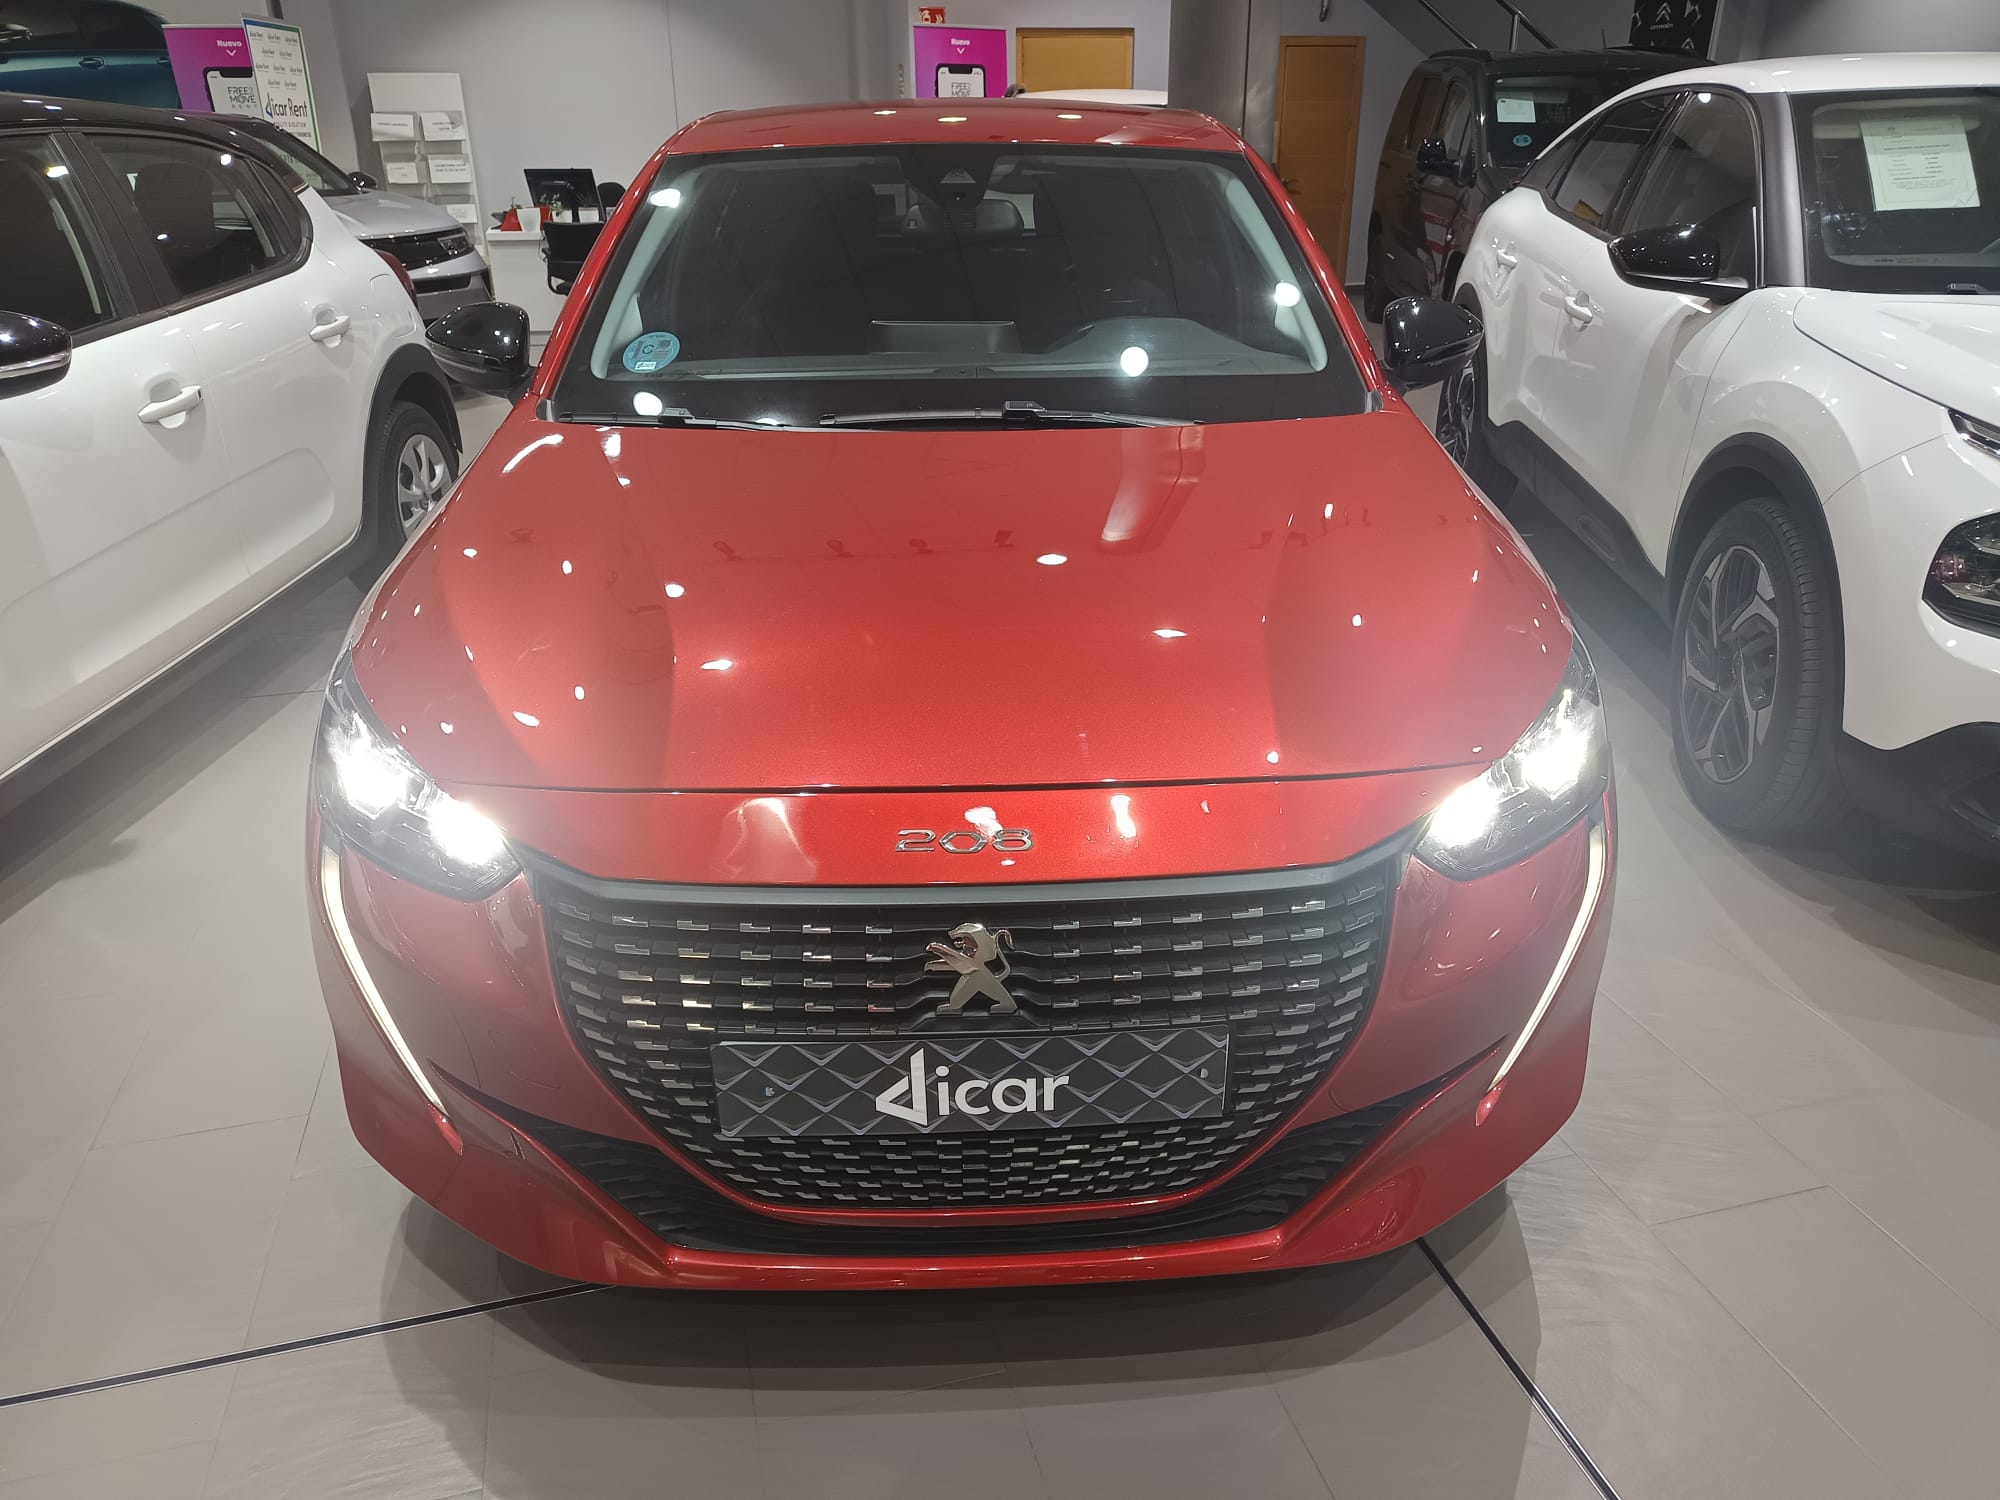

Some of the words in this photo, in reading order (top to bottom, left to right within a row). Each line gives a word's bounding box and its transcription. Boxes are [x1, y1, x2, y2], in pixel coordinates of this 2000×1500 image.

[229, 95, 257, 104] MOVE
[265, 92, 287, 118] dicar
[288, 97, 307, 118] Rent
[895, 829, 1034, 854] 208
[875, 1048, 1070, 1126] dicar
